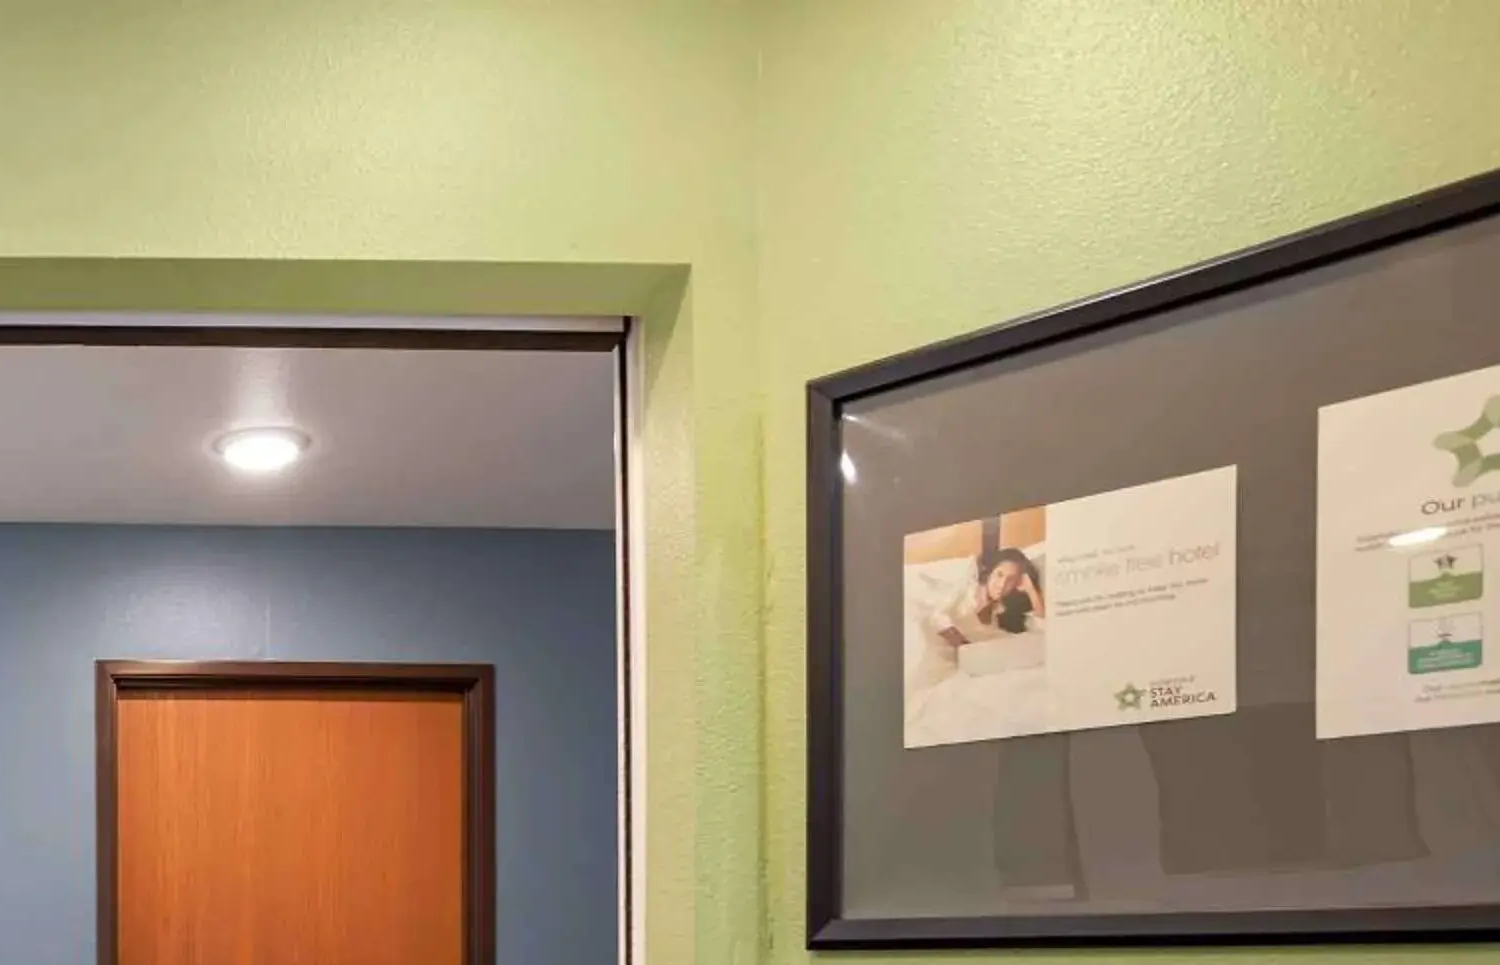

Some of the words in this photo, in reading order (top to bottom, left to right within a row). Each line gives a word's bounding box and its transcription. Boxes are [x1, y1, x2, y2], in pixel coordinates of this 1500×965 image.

[1421, 497, 1465, 515] Our
[1169, 540, 1221, 566] hotel
[1150, 686, 1183, 699] STAY
[1150, 691, 1217, 709] AMERICA
